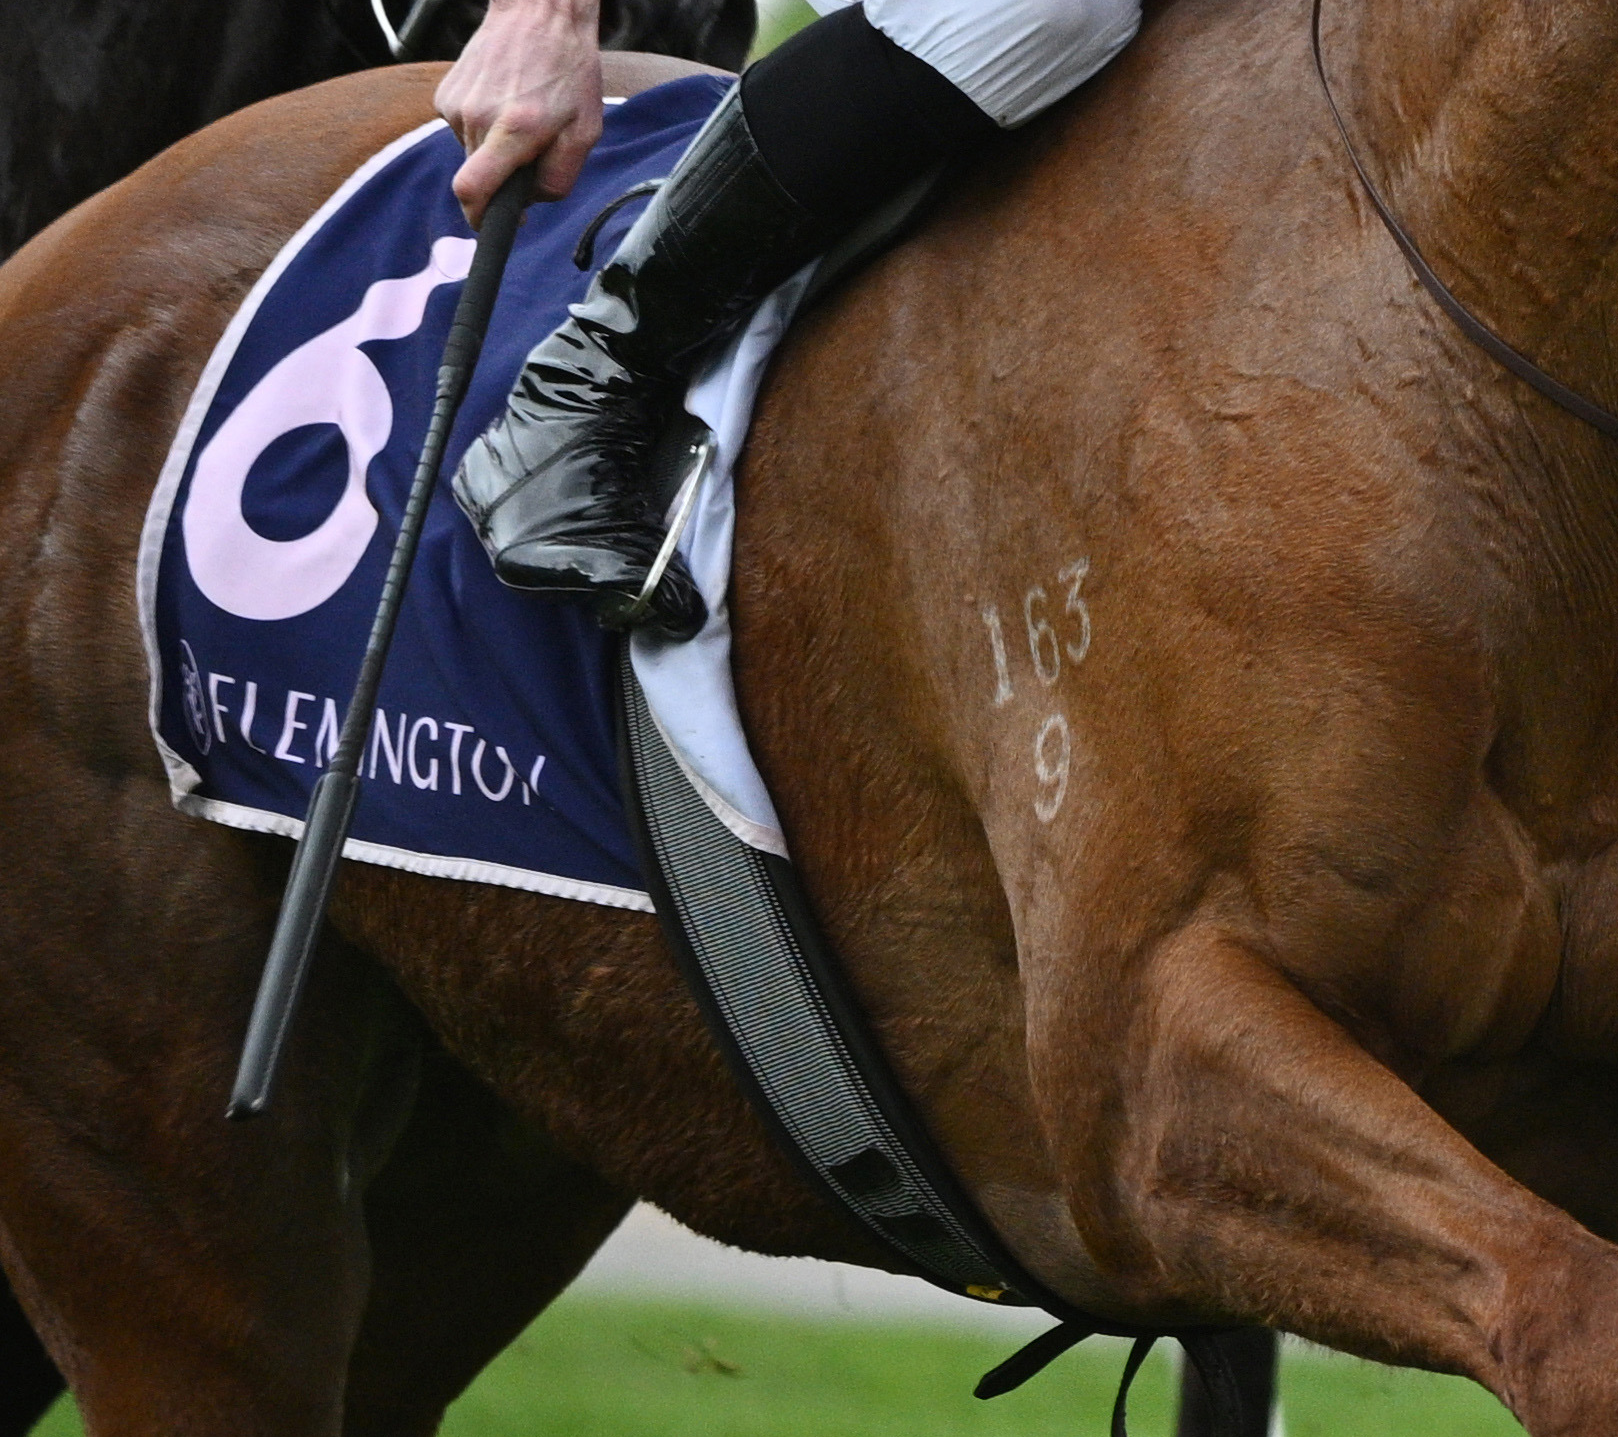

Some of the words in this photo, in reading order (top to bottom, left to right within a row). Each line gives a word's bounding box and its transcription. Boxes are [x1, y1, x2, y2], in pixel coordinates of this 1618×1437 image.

[181, 235, 478, 622] 6
[980, 556, 1092, 706] 163
[207, 672, 546, 806] FLEMNGTON
[1033, 713, 1072, 824] 9
